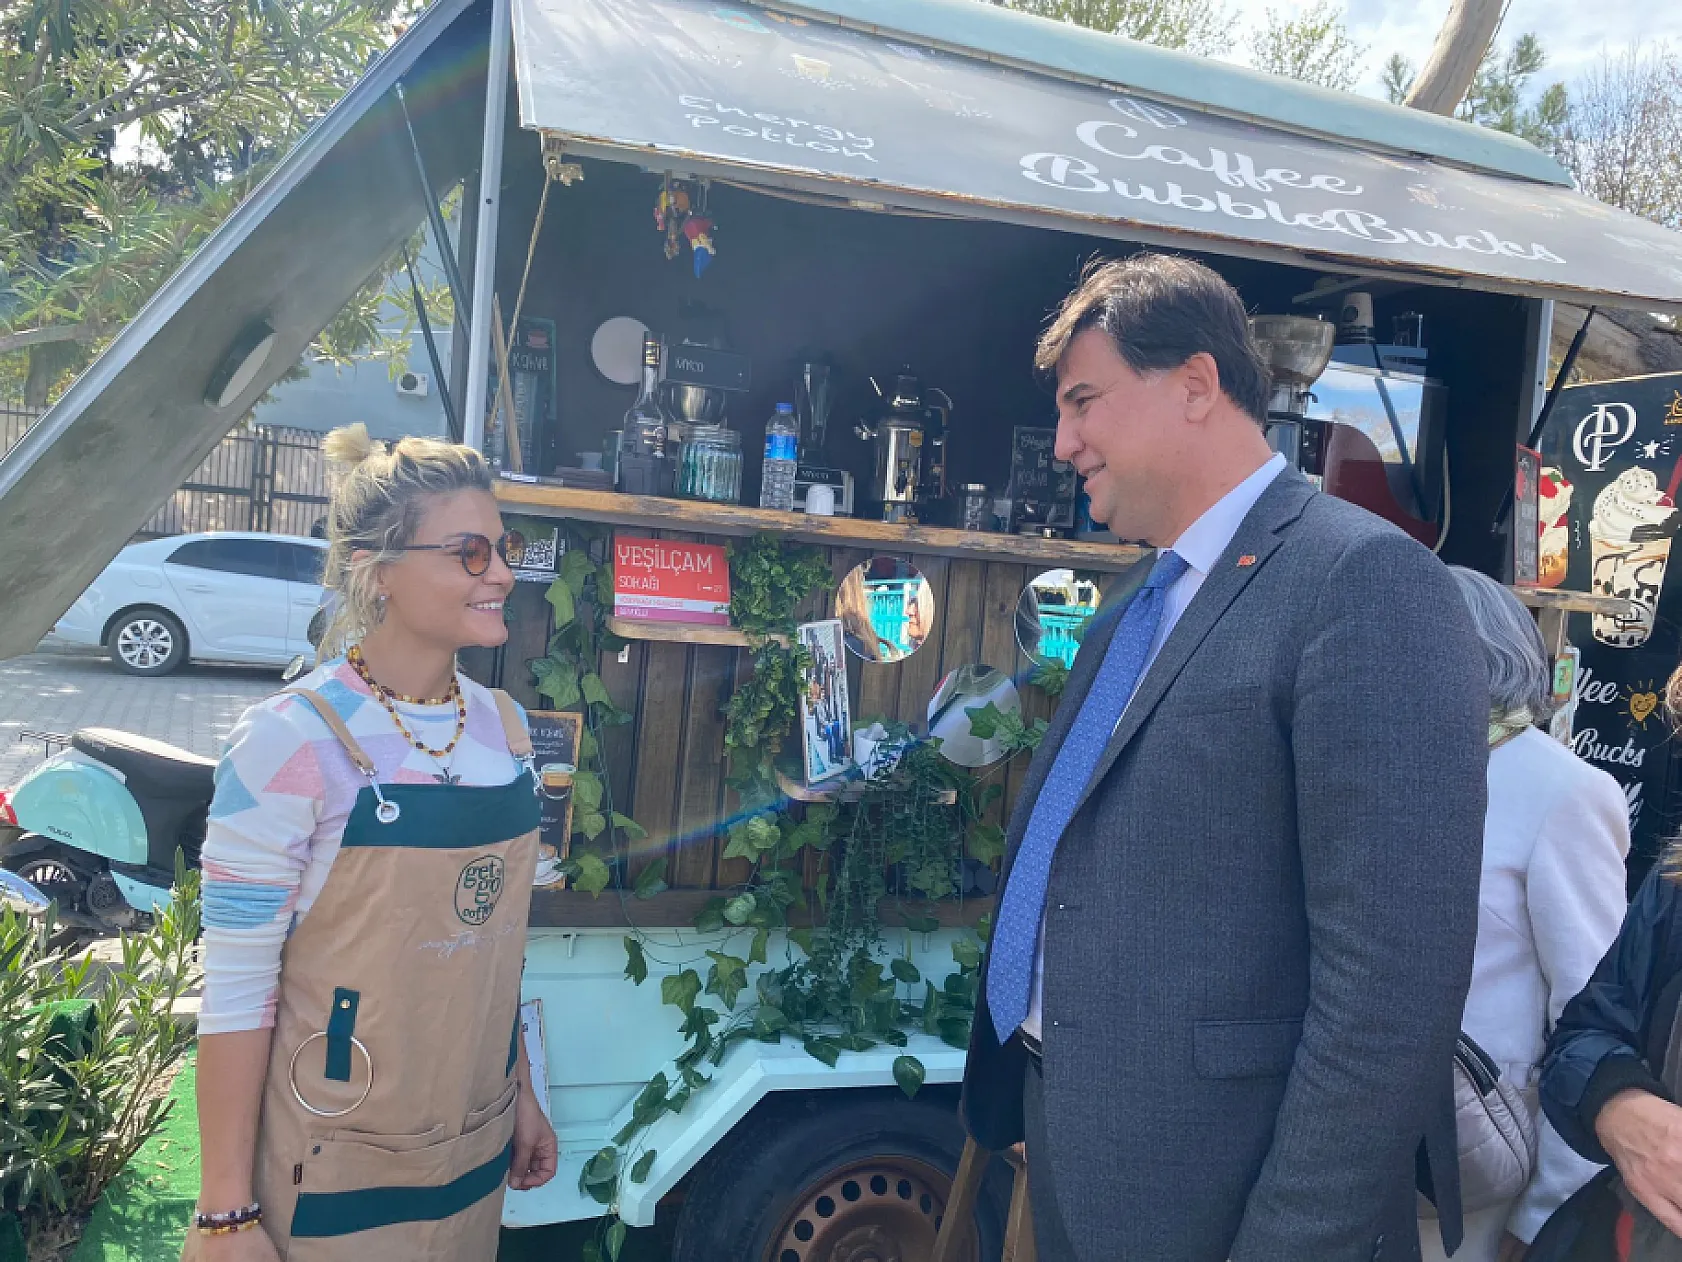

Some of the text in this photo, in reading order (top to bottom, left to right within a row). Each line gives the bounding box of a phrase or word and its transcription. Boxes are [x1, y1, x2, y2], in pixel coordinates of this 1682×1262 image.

[678, 94, 875, 149] Energy
[684, 113, 879, 163] Potion
[1076, 121, 1364, 195] Coffee
[617, 544, 713, 577] YEŞİLÇAM
